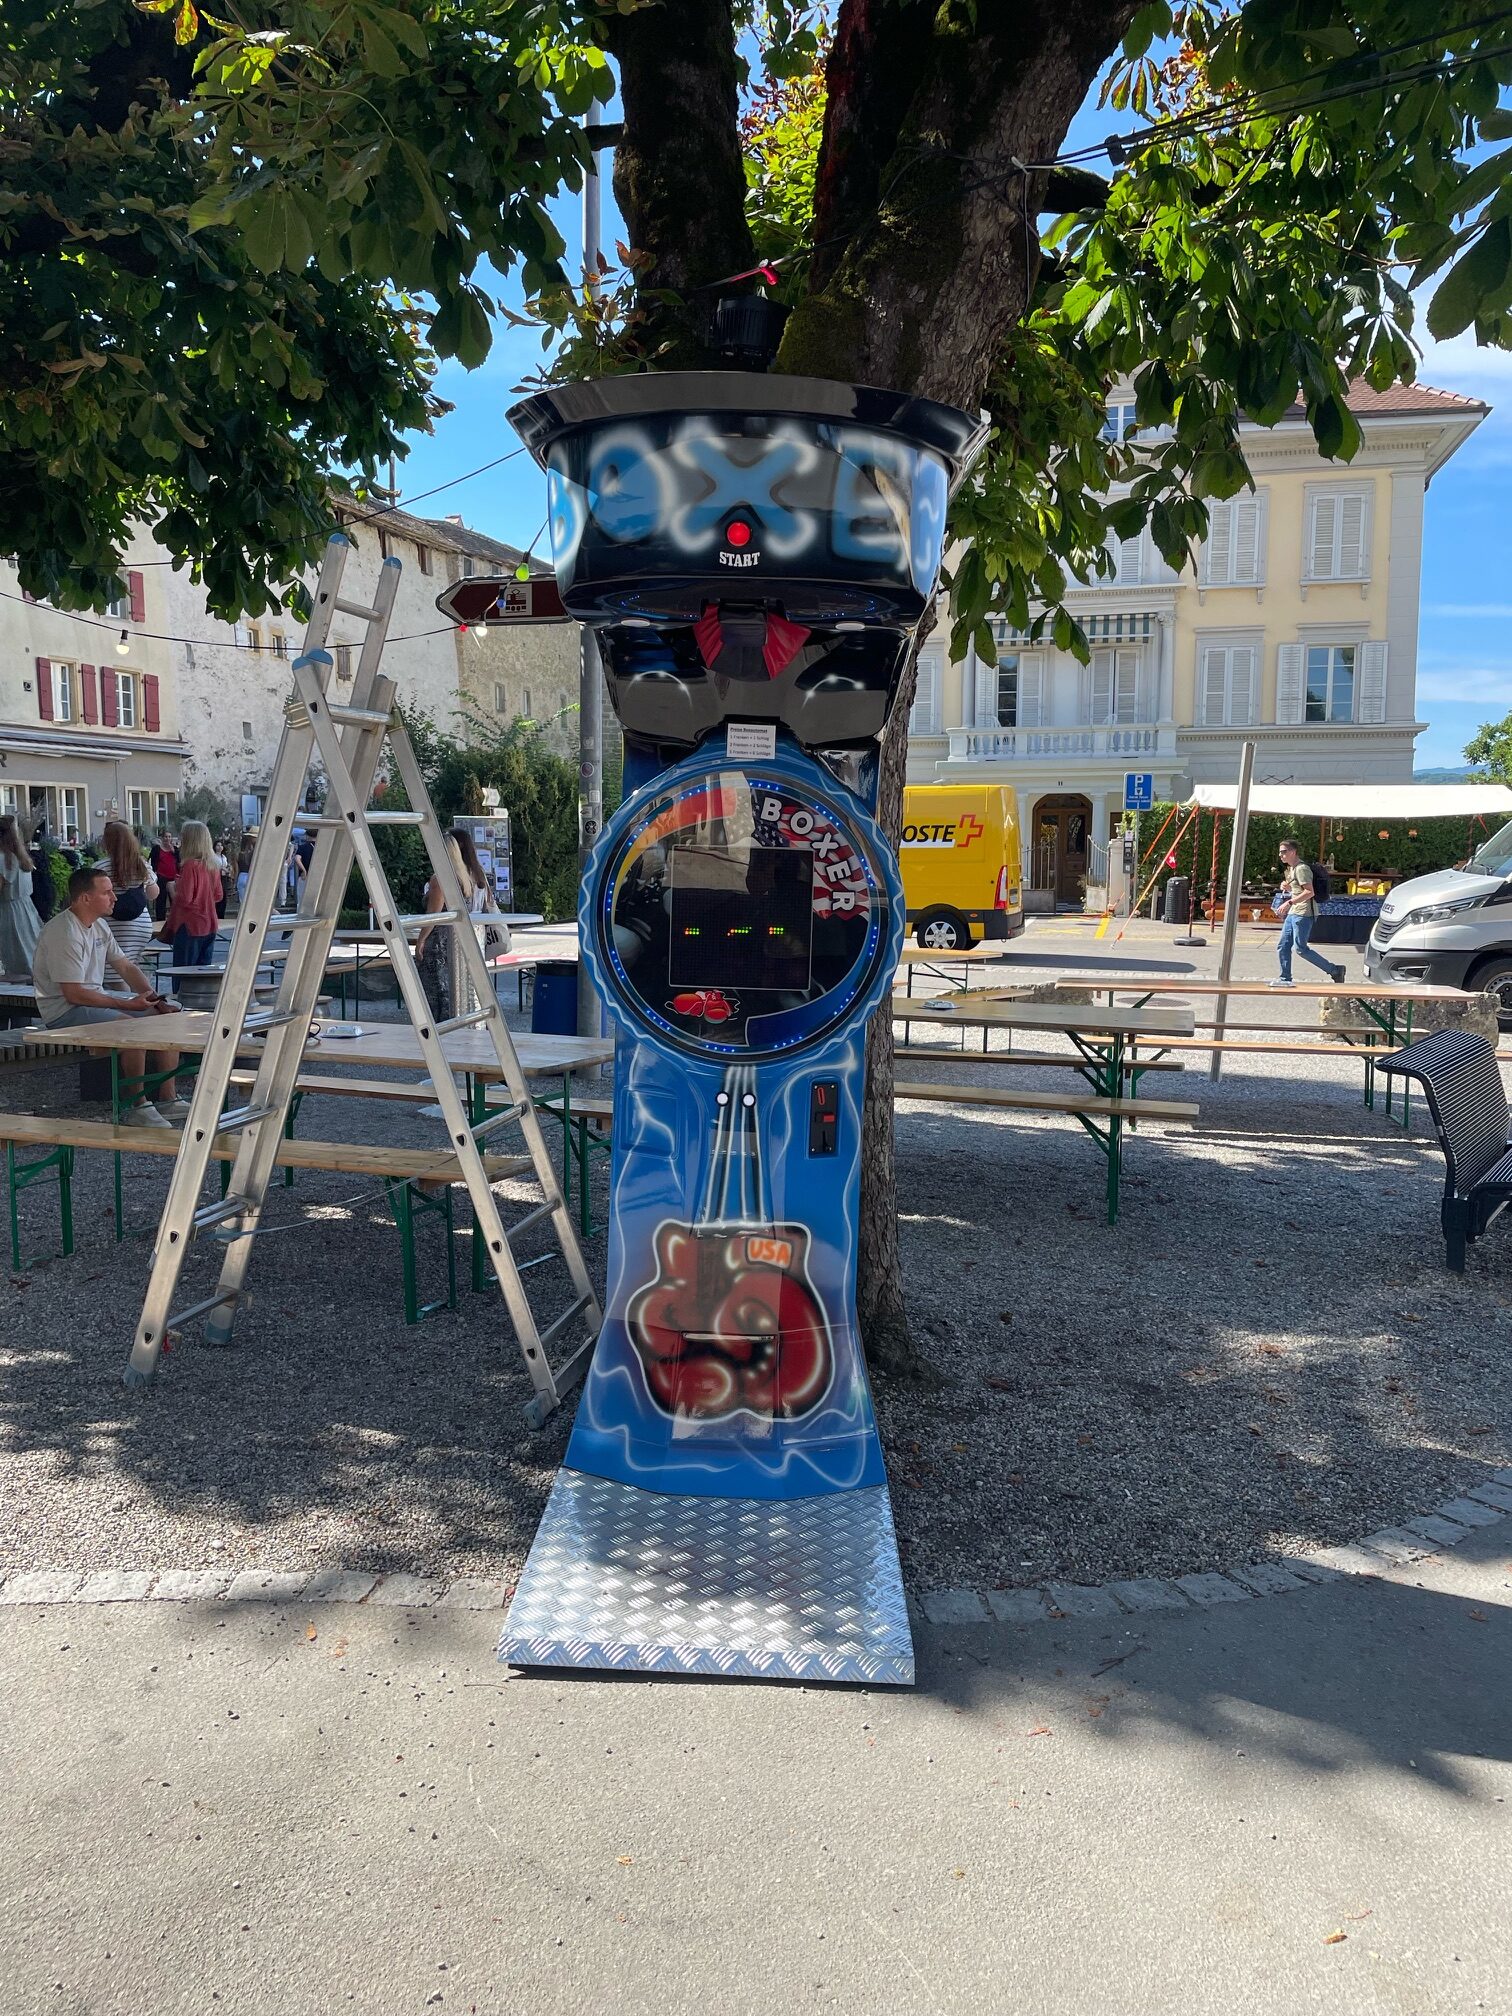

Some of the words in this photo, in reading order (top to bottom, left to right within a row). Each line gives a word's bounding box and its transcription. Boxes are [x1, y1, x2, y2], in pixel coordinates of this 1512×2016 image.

[719, 551, 761, 567] START
[1134, 775, 1144, 788] P
[901, 824, 956, 843] OSTE
[760, 797, 855, 911] BOXER
[749, 1240, 791, 1265] USA
